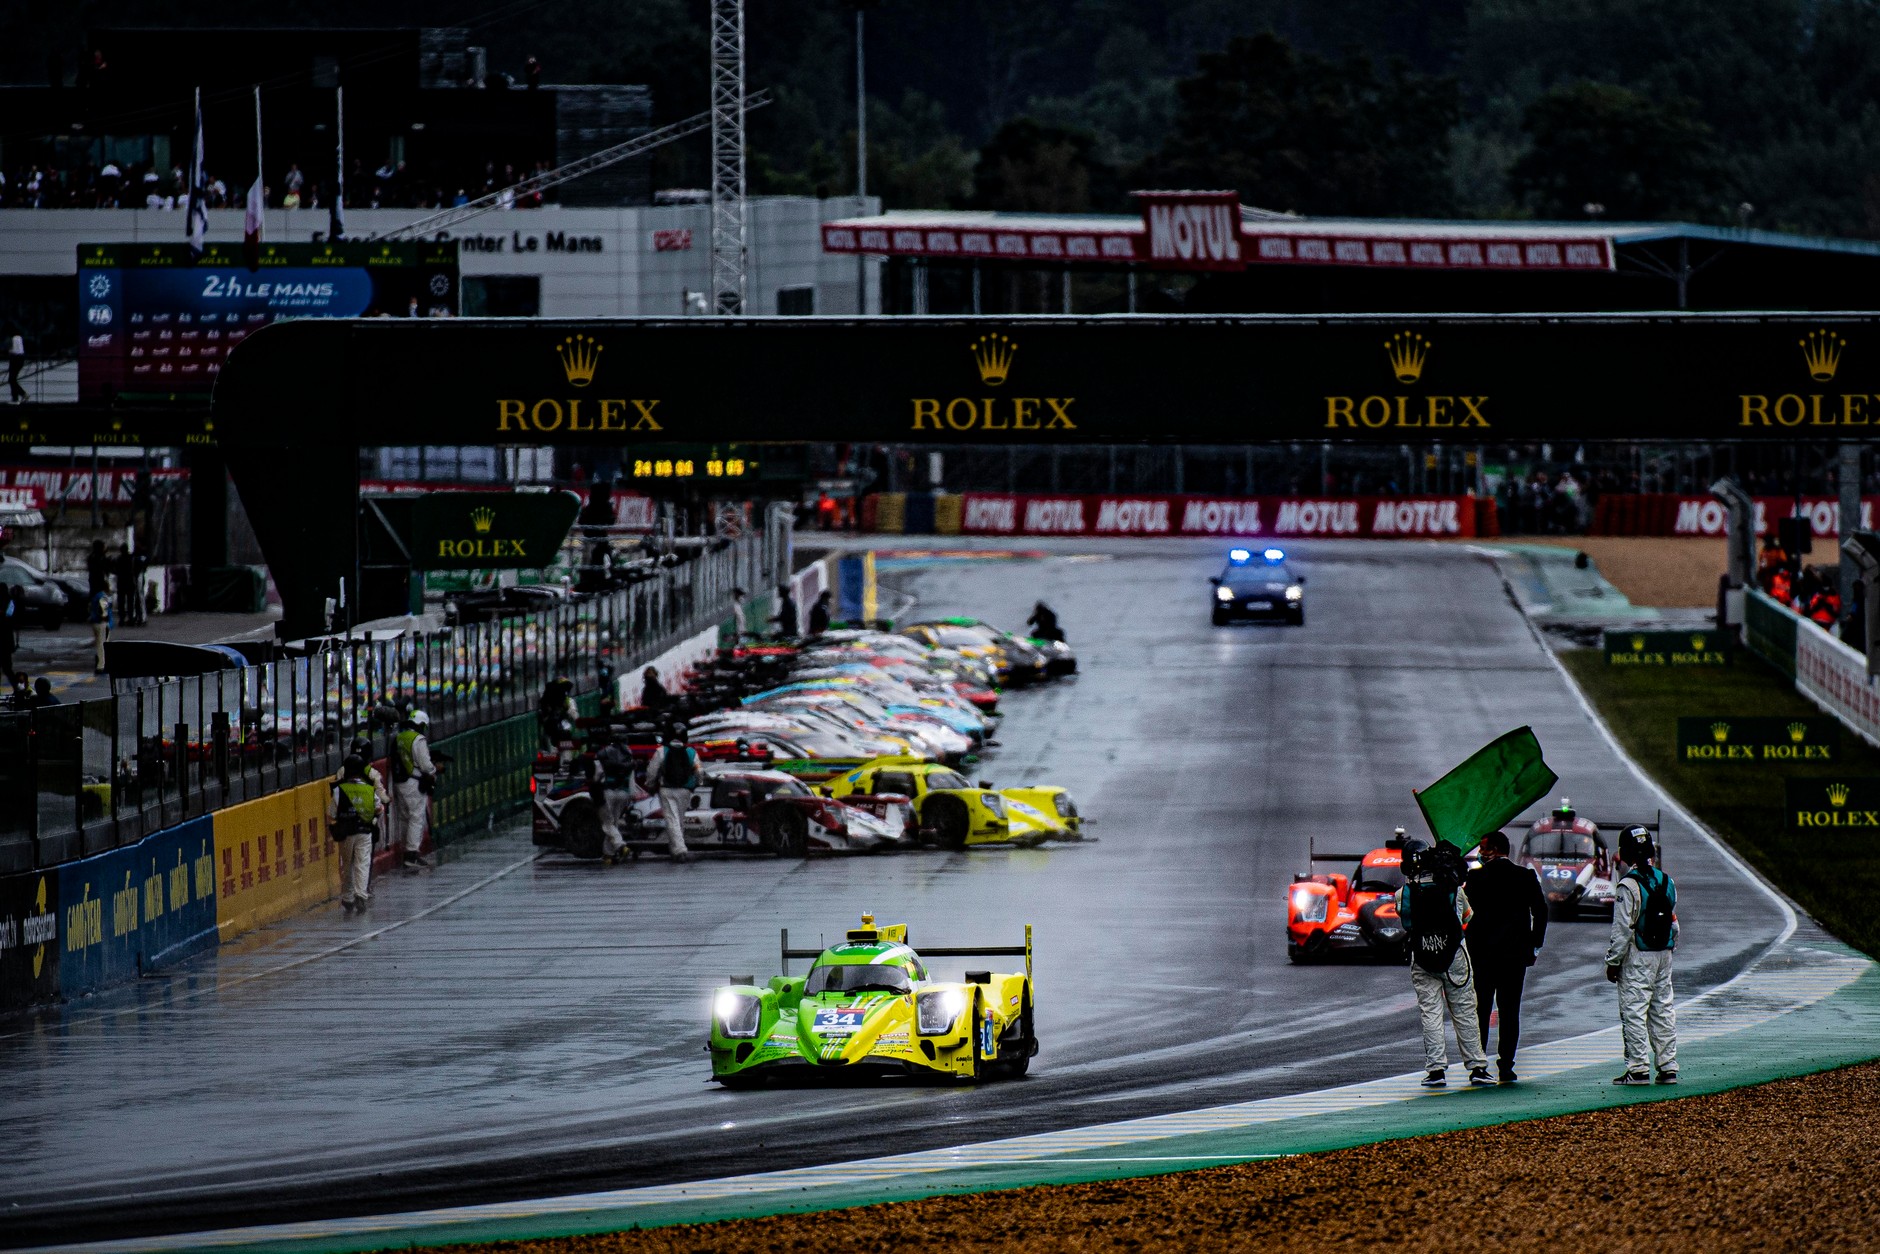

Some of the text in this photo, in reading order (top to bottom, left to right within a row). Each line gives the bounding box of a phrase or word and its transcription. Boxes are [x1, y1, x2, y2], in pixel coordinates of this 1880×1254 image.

[513, 230, 537, 253] Le
[546, 230, 603, 252] Mans
[1149, 204, 1241, 261] MOTUL
[245, 283, 271, 298] LE
[273, 282, 333, 297] MANS
[496, 398, 664, 432] ROLEX
[911, 397, 1077, 431] ROLEX
[1324, 395, 1491, 429] ROLEX
[1738, 393, 1880, 427] ROLE
[0, 433, 48, 443] ROLEX
[93, 433, 141, 443] ROLEX
[186, 433, 213, 444] ROL
[963, 498, 1016, 531] MOTUL
[1023, 499, 1086, 532] MOTUL
[1096, 499, 1170, 533] MOTUL
[1181, 500, 1262, 533] MOTUL
[1274, 500, 1359, 533] MOTUL
[1371, 500, 1461, 533] MOTUL
[1674, 500, 1768, 535] MOL
[438, 539, 527, 558] ROLEX
[1610, 652, 1725, 665] ROLEX ROLEX
[1686, 745, 1832, 759] ROLEX ROLEX
[726, 821, 744, 840] 20
[1796, 811, 1880, 827] ROLEX
[1546, 869, 1572, 879] 49
[821, 1013, 856, 1025] 34
